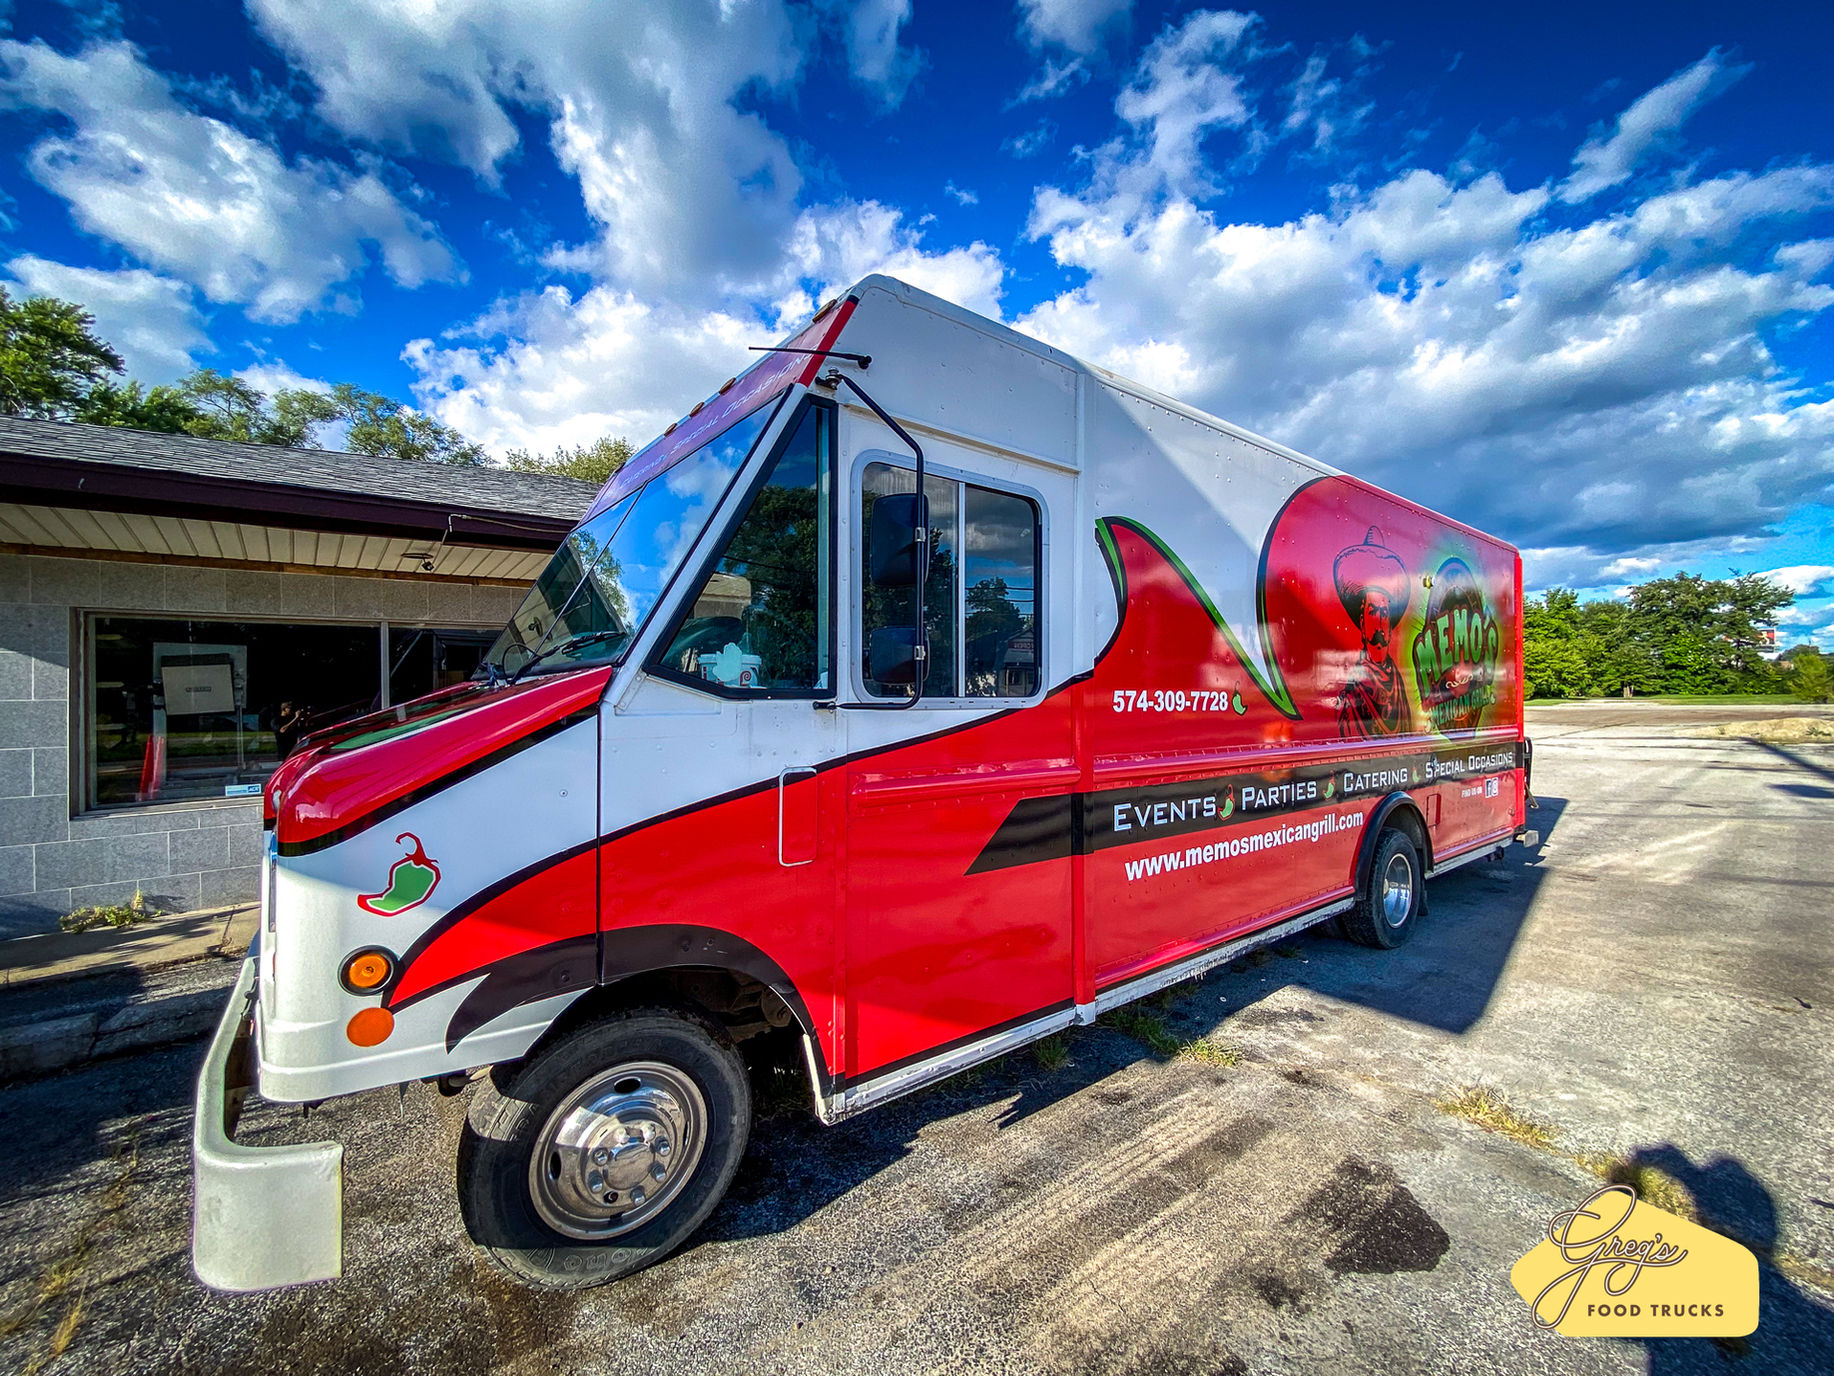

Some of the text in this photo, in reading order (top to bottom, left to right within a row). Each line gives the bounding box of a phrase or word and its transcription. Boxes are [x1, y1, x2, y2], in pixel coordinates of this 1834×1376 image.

[1415, 608, 1498, 699] MEMO'S
[1112, 689, 1229, 713] 574-309-7728
[1113, 751, 1513, 832] EVENTS PARTIES CATERING SPECIAL OCCASIONS
[1124, 811, 1364, 881] www.memosmexicangrill.com
